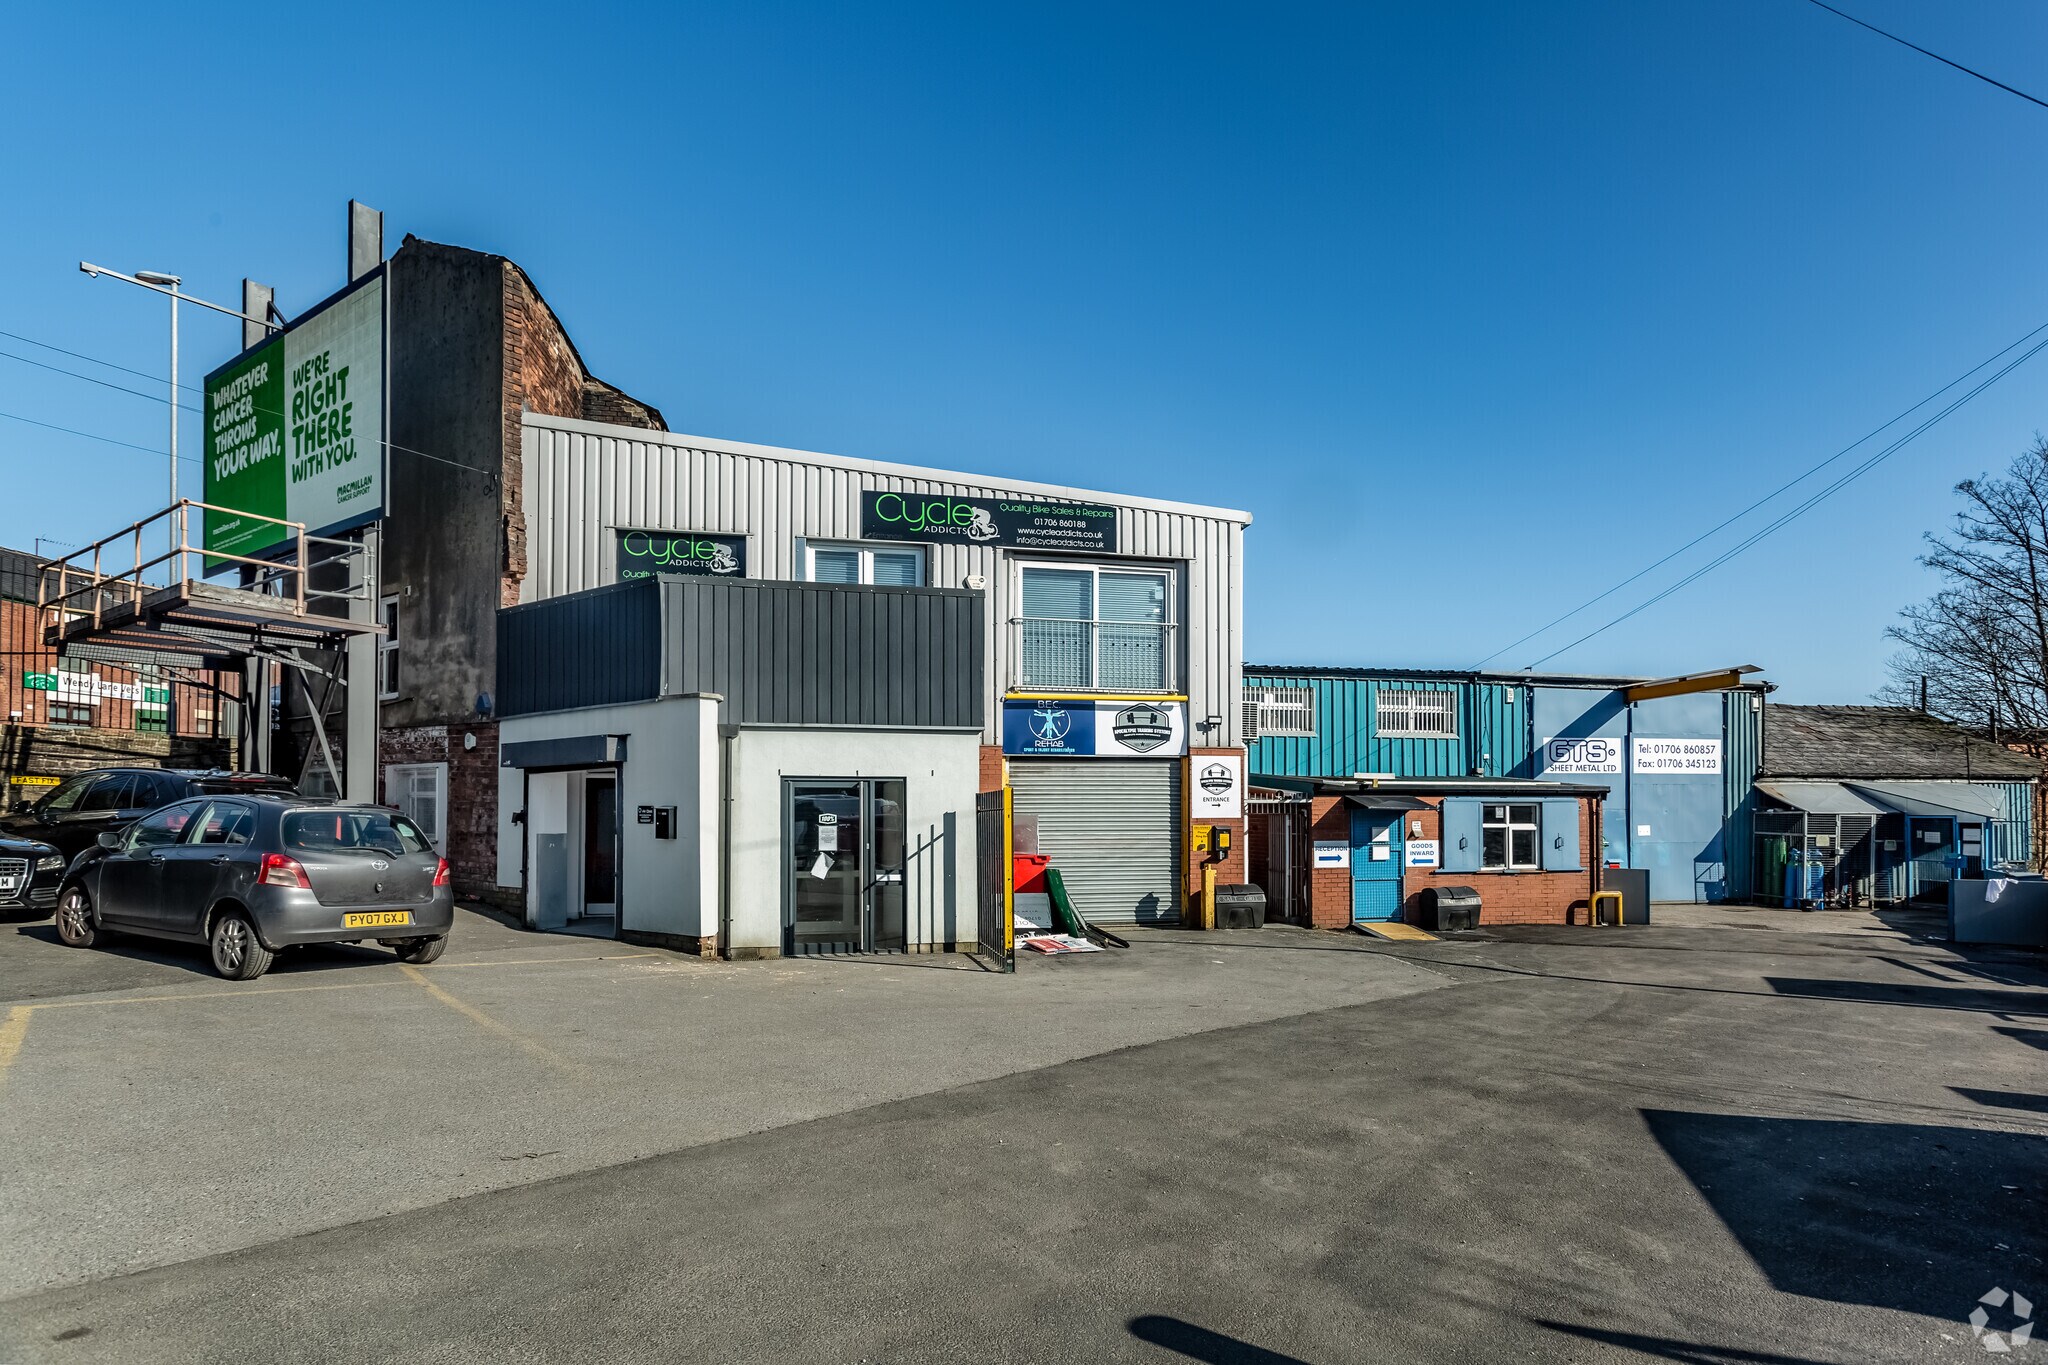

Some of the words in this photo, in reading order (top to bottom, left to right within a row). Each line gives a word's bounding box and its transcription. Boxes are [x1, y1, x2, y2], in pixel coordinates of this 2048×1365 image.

[293, 350, 330, 389] WE'RE
[213, 361, 269, 410] WHATEVER
[292, 365, 350, 425] RIGHT
[213, 394, 254, 433] CANCER
[214, 415, 257, 455] THROWS
[292, 401, 353, 460] THERE
[214, 444, 248, 482] YOUR
[249, 428, 282, 465] WAY,
[291, 451, 324, 484] WITH
[325, 437, 358, 471] YOU.
[336, 474, 373, 498] MACMILLAN
[352, 485, 371, 500] SUPPORT
[876, 493, 975, 532] Cycle
[1000, 502, 1032, 515] Quality
[1032, 504, 1050, 514] Bike
[1051, 506, 1075, 516] Sales
[1075, 508, 1081, 516] &
[1082, 508, 1114, 519] Repairs
[923, 525, 968, 535] ADDICTS
[1034, 517, 1058, 527] 01706
[1058, 519, 1087, 529] 860188
[1017, 527, 1103, 539] www.cycleaddicts.co.uk
[623, 531, 716, 565] Cycle
[668, 559, 710, 568] ADDICTS
[62, 676, 95, 690] Wendy
[97, 680, 118, 692] Lane
[120, 684, 140, 695] Vets
[1034, 740, 1065, 748] REHAB
[1550, 739, 1608, 763] GTS
[1638, 744, 1652, 754] Tel:
[1654, 744, 1682, 755] 01706
[1683, 745, 1716, 755] 860857
[1550, 764, 1574, 772] SHEET
[1575, 764, 1601, 772] METAL
[1603, 764, 1617, 772] LTD
[1638, 758, 1655, 769] Fax:
[1657, 758, 1683, 769] 01706
[1685, 759, 1717, 769] 345123
[16, 776, 39, 784] FAST
[41, 777, 55, 785] FIX
[350, 914, 381, 926] PY07
[383, 913, 405, 923] GXJ
